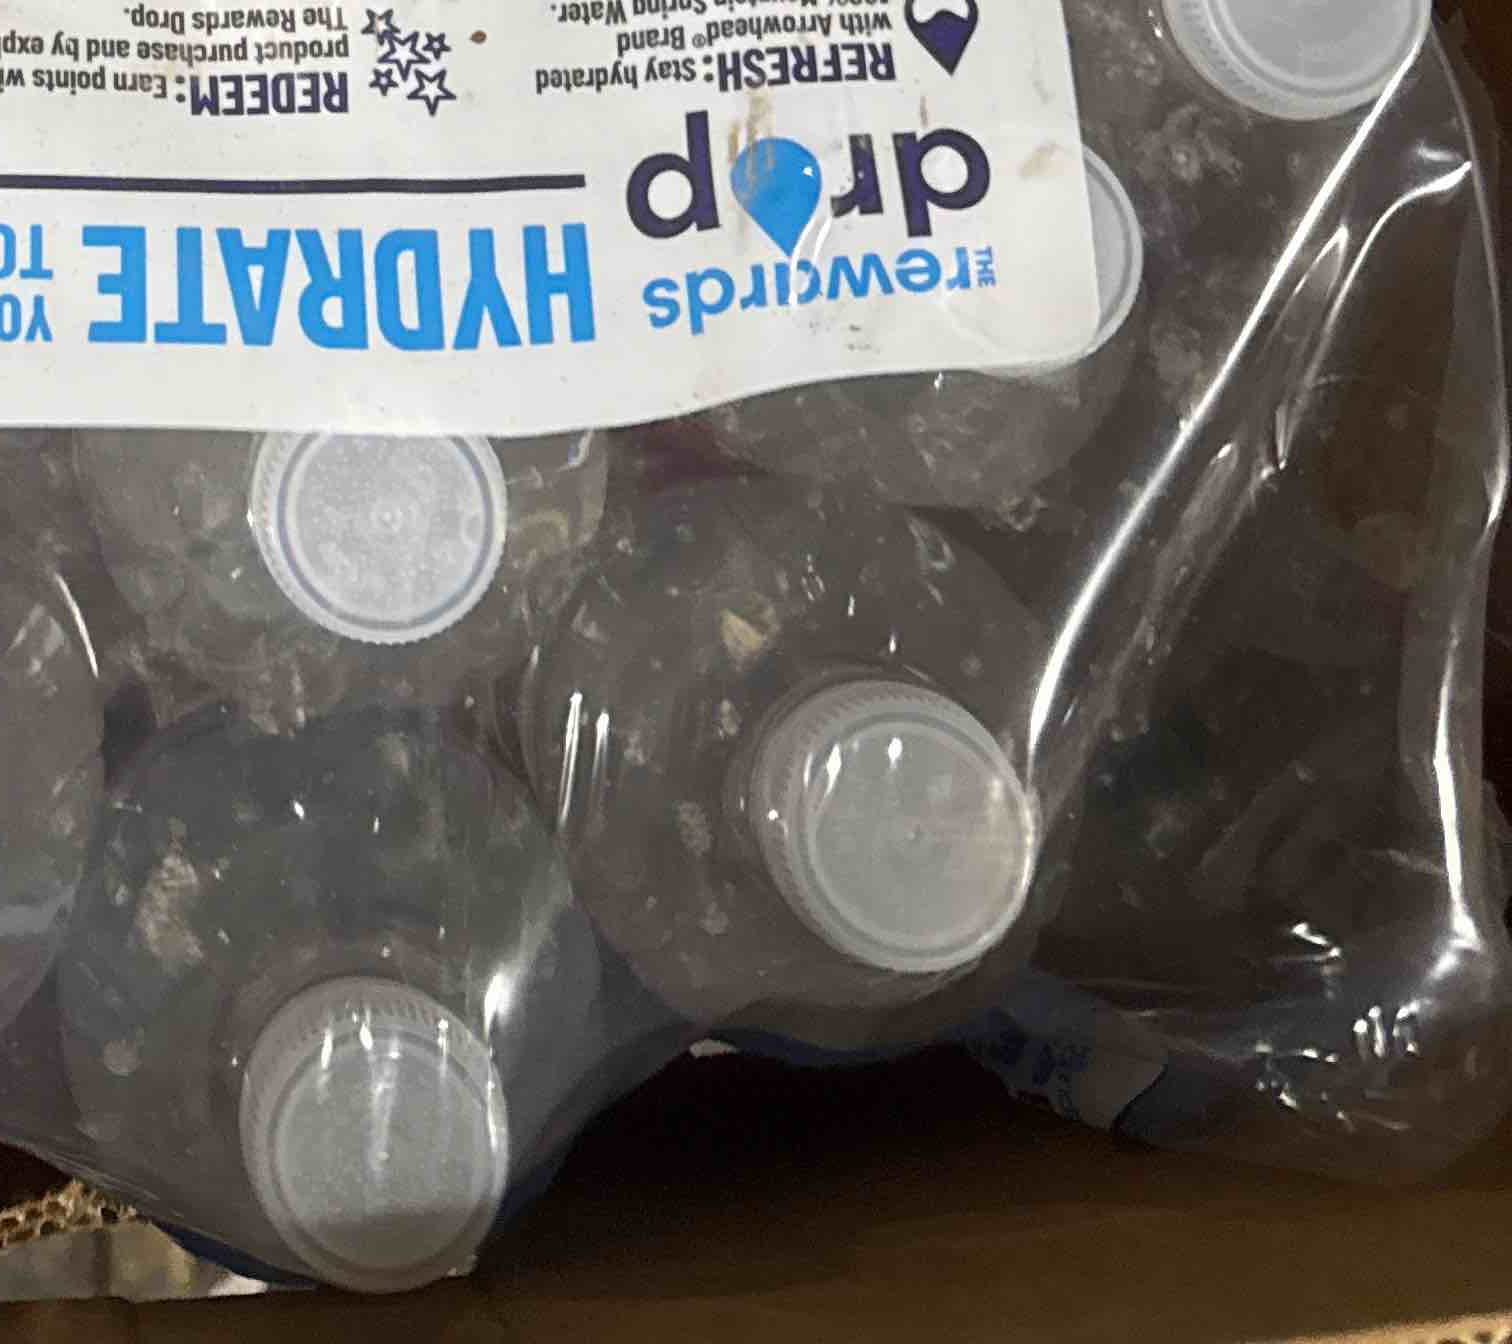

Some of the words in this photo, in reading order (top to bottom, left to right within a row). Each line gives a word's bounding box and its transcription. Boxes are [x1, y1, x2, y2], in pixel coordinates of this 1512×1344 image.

[123, 4, 186, 35] Drop.
[190, 7, 297, 35] Rewards
[303, 5, 347, 32] The
[550, 0, 627, 25] Water.
[840, 12, 892, 36] with
[48, 32, 81, 62] by
[87, 37, 131, 63] and
[135, 34, 249, 64] purchase
[254, 33, 350, 64] product
[616, 30, 685, 55] Brand
[31, 66, 107, 94] points
[534, 65, 638, 94] hydrated
[644, 56, 696, 83] Stay
[701, 42, 896, 93] REFRESH:
[113, 71, 168, 99] Earn
[174, 71, 350, 116] REDEEM:
[973, 246, 997, 288] THE
[81, 223, 596, 352] HYDRATE
[641, 246, 972, 336] rewards
